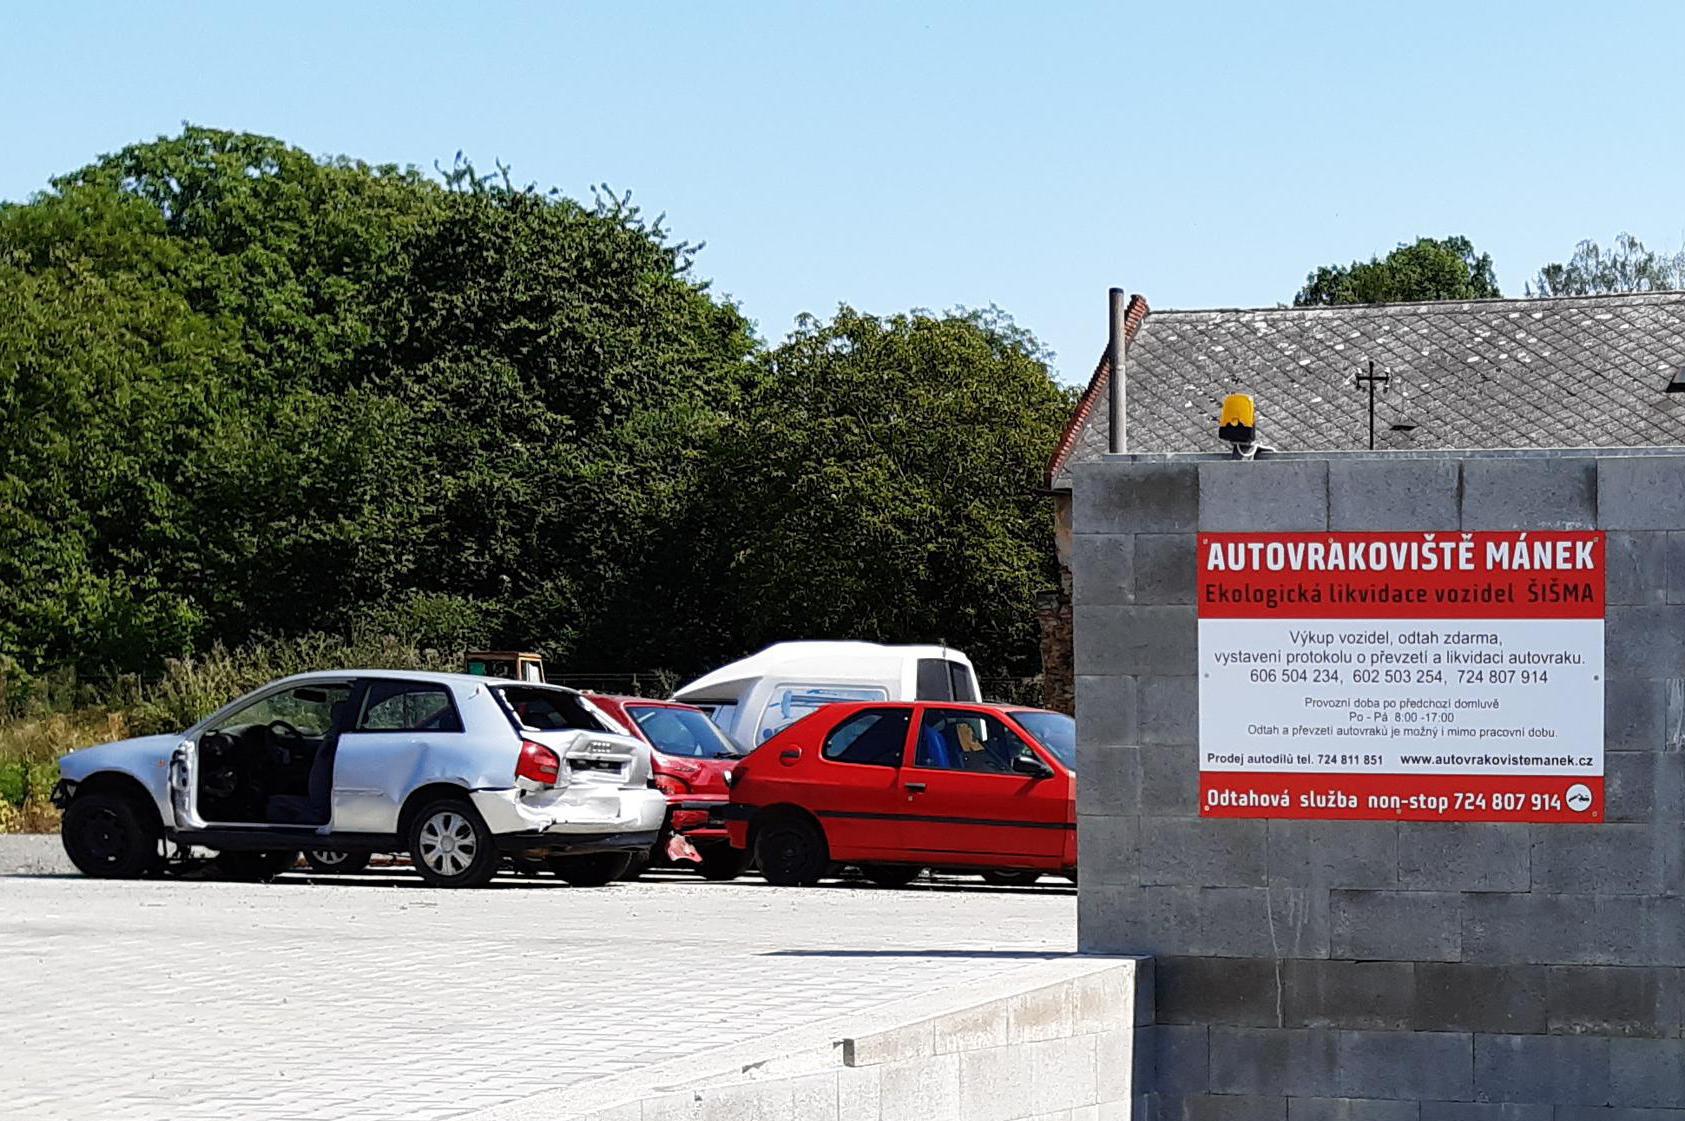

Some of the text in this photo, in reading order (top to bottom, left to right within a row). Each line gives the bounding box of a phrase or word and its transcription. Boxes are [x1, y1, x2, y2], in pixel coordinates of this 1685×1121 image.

[1207, 533, 1594, 571] AUTOVRAKOVIŠTĚ MÁNEK
[1205, 578, 1594, 608] Ekologická likvidace vozidel ŠIŠMA
[1289, 630, 1503, 646] Výkup vozidel, odtah zdarma,
[1214, 650, 1585, 666] vystavení protokolu o převzetí a likvidaci autovraku.
[1250, 669, 1548, 685] 606 504 234, 602 503 254, 724 807 914
[1354, 697, 1380, 708] doba
[1383, 700, 1396, 712] po
[1350, 712, 1363, 722] Po
[1395, 712, 1418, 722] 8:00
[1248, 724, 1279, 735] Odtah
[1282, 727, 1289, 735] a
[1390, 726, 1400, 738] je
[1447, 727, 1476, 737] mimo
[1528, 728, 1557, 737] dobu.
[1207, 753, 1244, 766] Prodej
[1297, 754, 1314, 764] tel.
[1318, 754, 1337, 764] 724
[1341, 755, 1361, 765] 811
[1363, 755, 1383, 765] 851
[1401, 754, 1593, 766] www.autovrakovistemanek.cz
[1207, 788, 1561, 813] Odtahová služba non-stop 724 807 914
